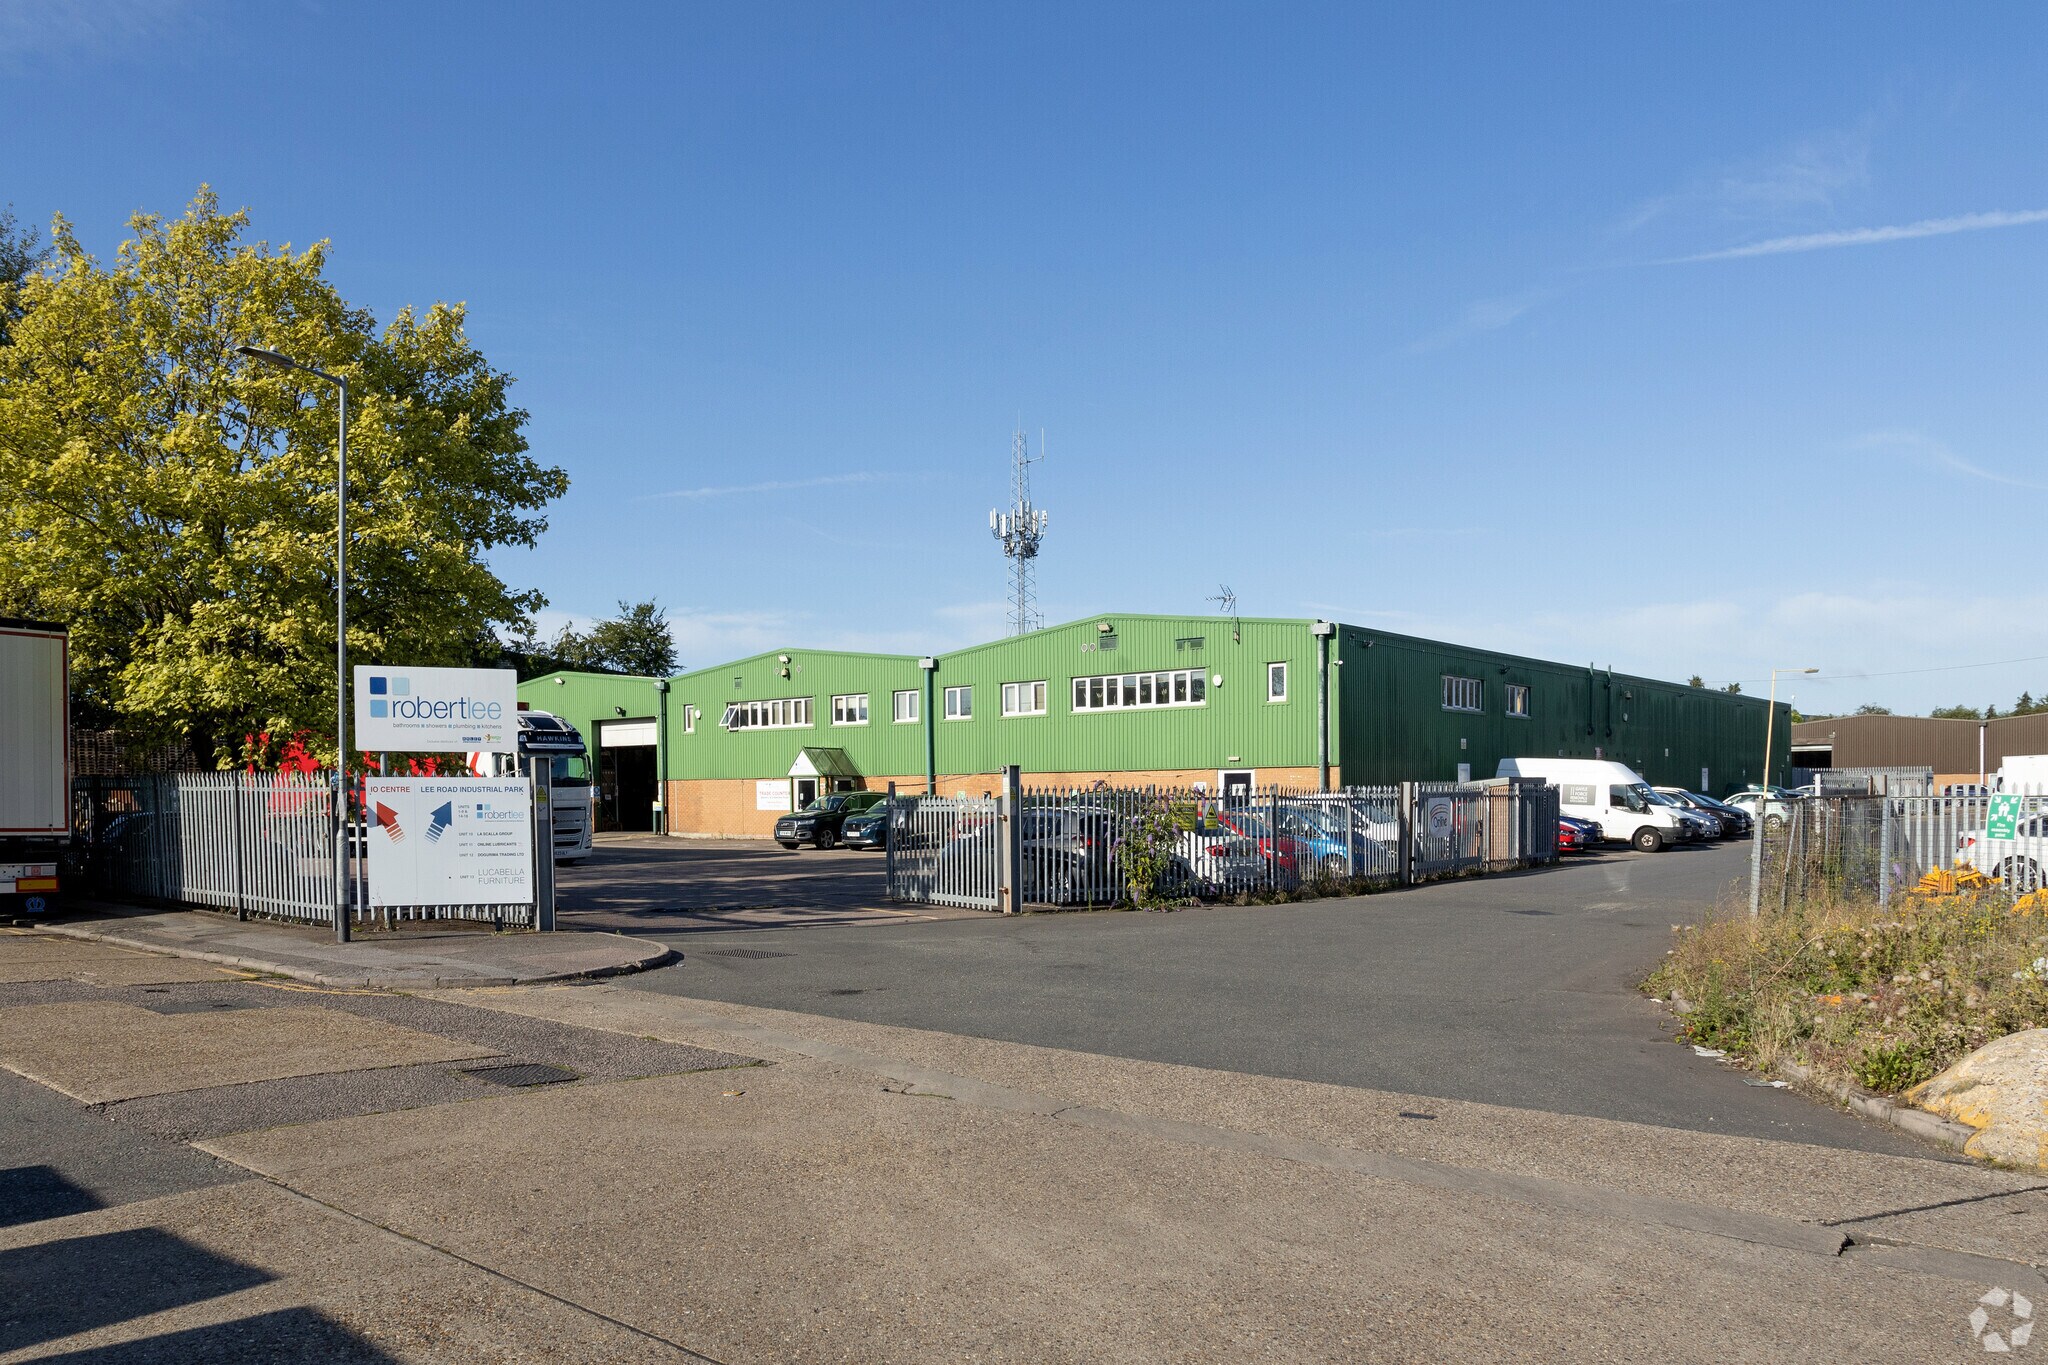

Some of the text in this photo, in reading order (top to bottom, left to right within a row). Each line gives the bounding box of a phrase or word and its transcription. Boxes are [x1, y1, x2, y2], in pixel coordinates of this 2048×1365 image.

[393, 696, 501, 720] robertlee
[484, 810, 524, 819] robertlee
[478, 868, 525, 876] LUCABELLA
[478, 876, 525, 884] FURNITURE
